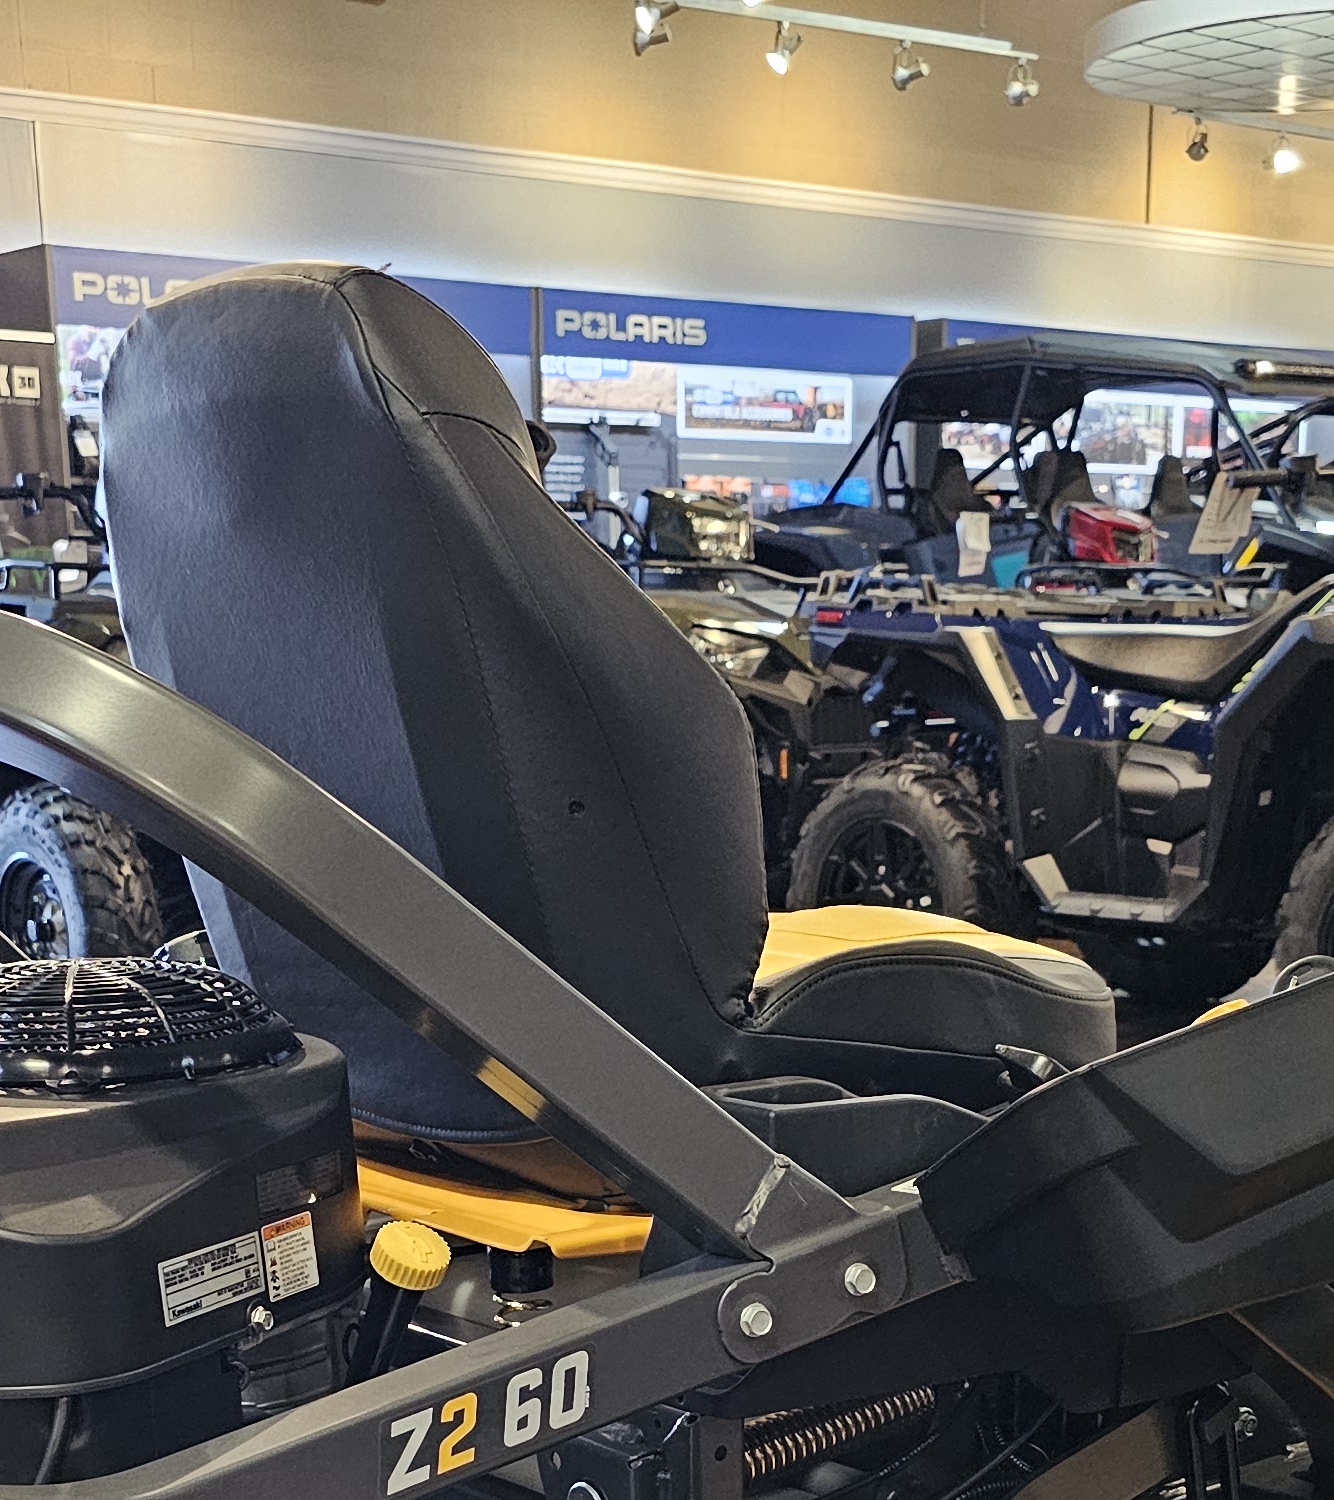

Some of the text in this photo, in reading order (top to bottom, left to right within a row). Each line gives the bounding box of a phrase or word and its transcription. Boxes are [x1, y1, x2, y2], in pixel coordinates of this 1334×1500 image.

[72, 270, 193, 308] POL
[555, 308, 708, 346] POLARIS
[275, 1217, 305, 1235] WARNING
[387, 1350, 590, 1496] Z2 60
